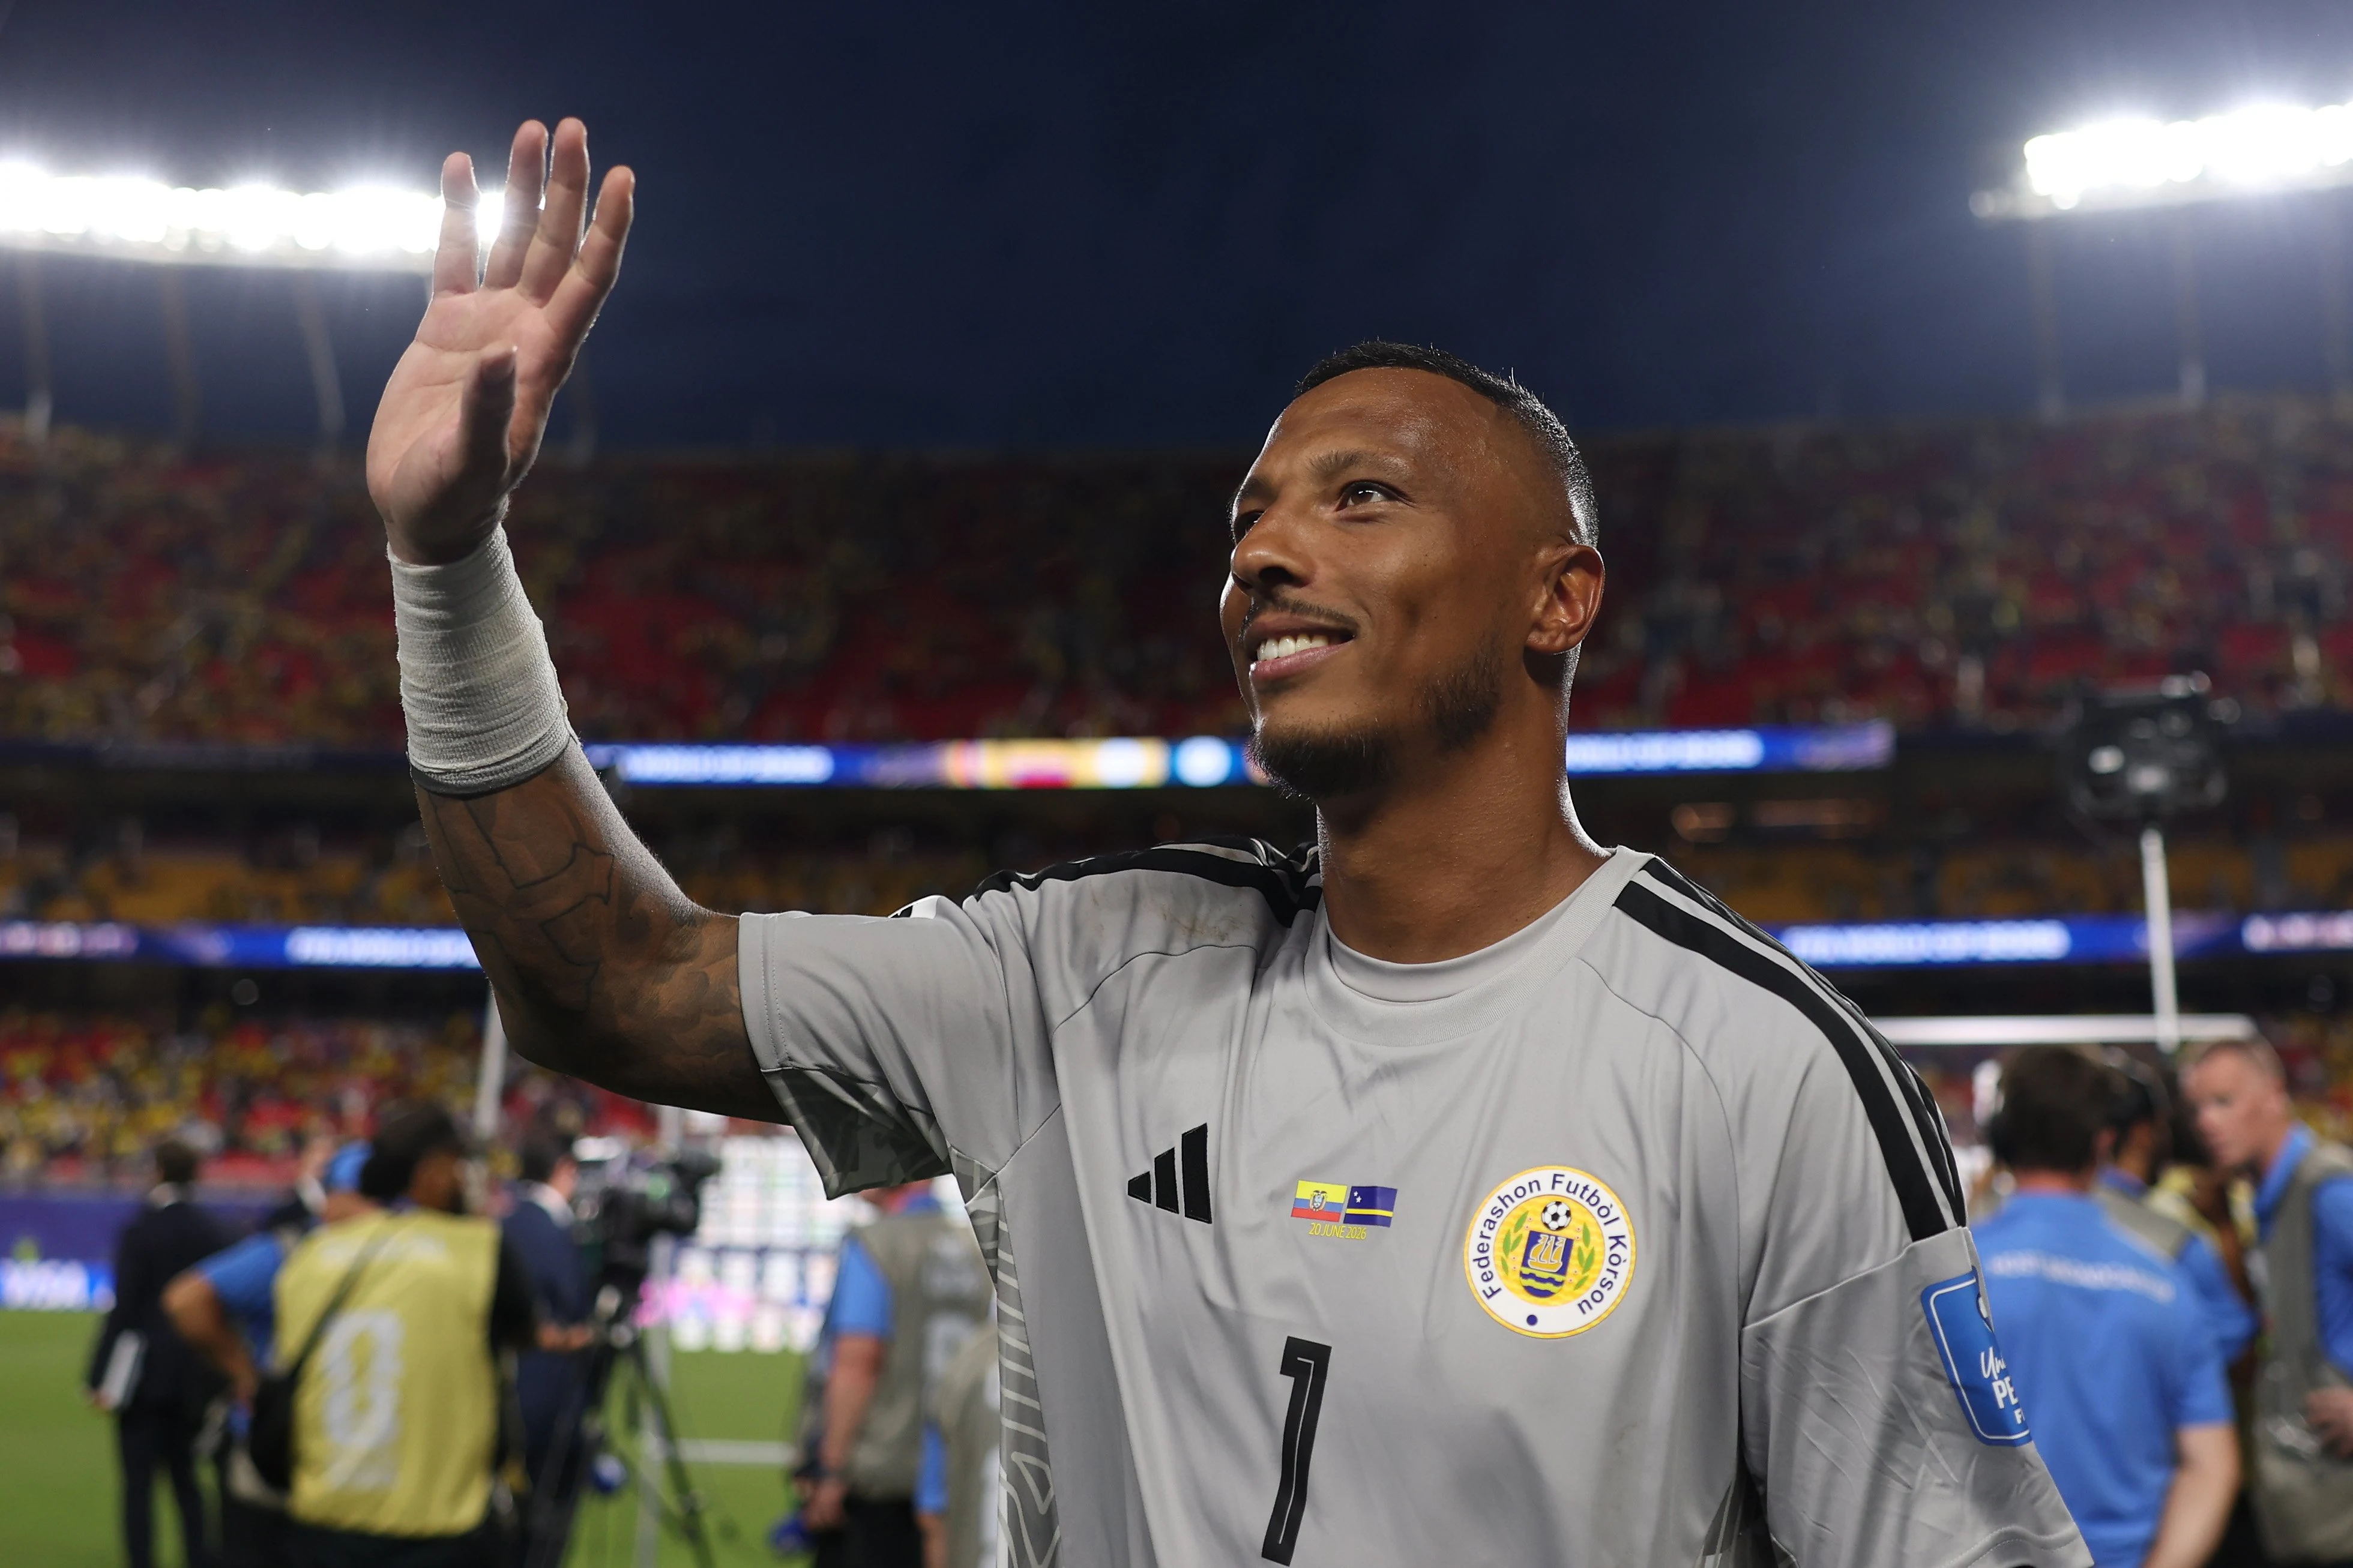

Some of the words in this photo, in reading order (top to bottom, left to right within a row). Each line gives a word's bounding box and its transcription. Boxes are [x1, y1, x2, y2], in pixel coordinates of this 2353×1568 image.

[1309, 1222, 1321, 1235] 20
[1321, 1224, 1346, 1238] JUNE
[1345, 1227, 1367, 1240] 2026
[1473, 1179, 1541, 1299] Federashon
[1551, 1173, 1619, 1226] Futbòl
[1577, 1234, 1627, 1314] Kòrsou
[1262, 1336, 1332, 1567] 1
